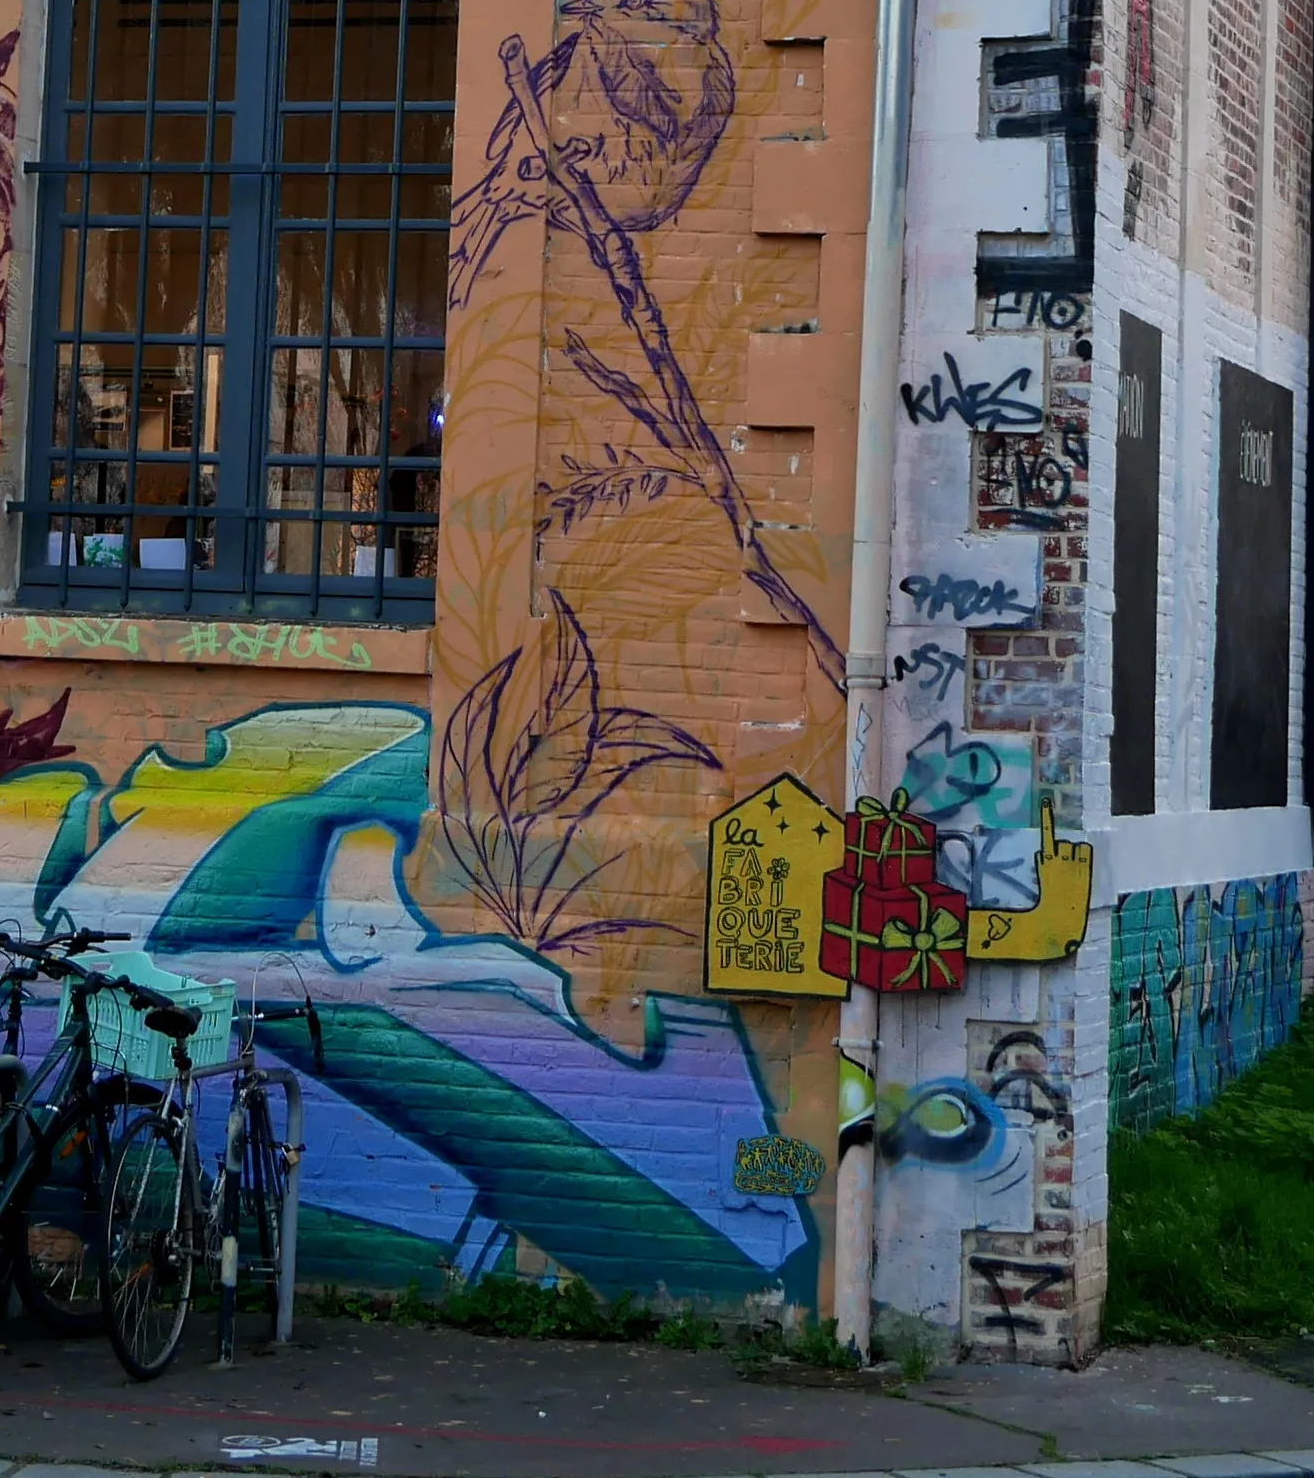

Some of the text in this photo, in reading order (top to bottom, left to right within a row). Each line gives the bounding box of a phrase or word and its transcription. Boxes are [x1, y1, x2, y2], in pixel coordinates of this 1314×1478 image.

[723, 817, 765, 847] la
[721, 847, 764, 877] FA
[716, 907, 801, 940] QUE
